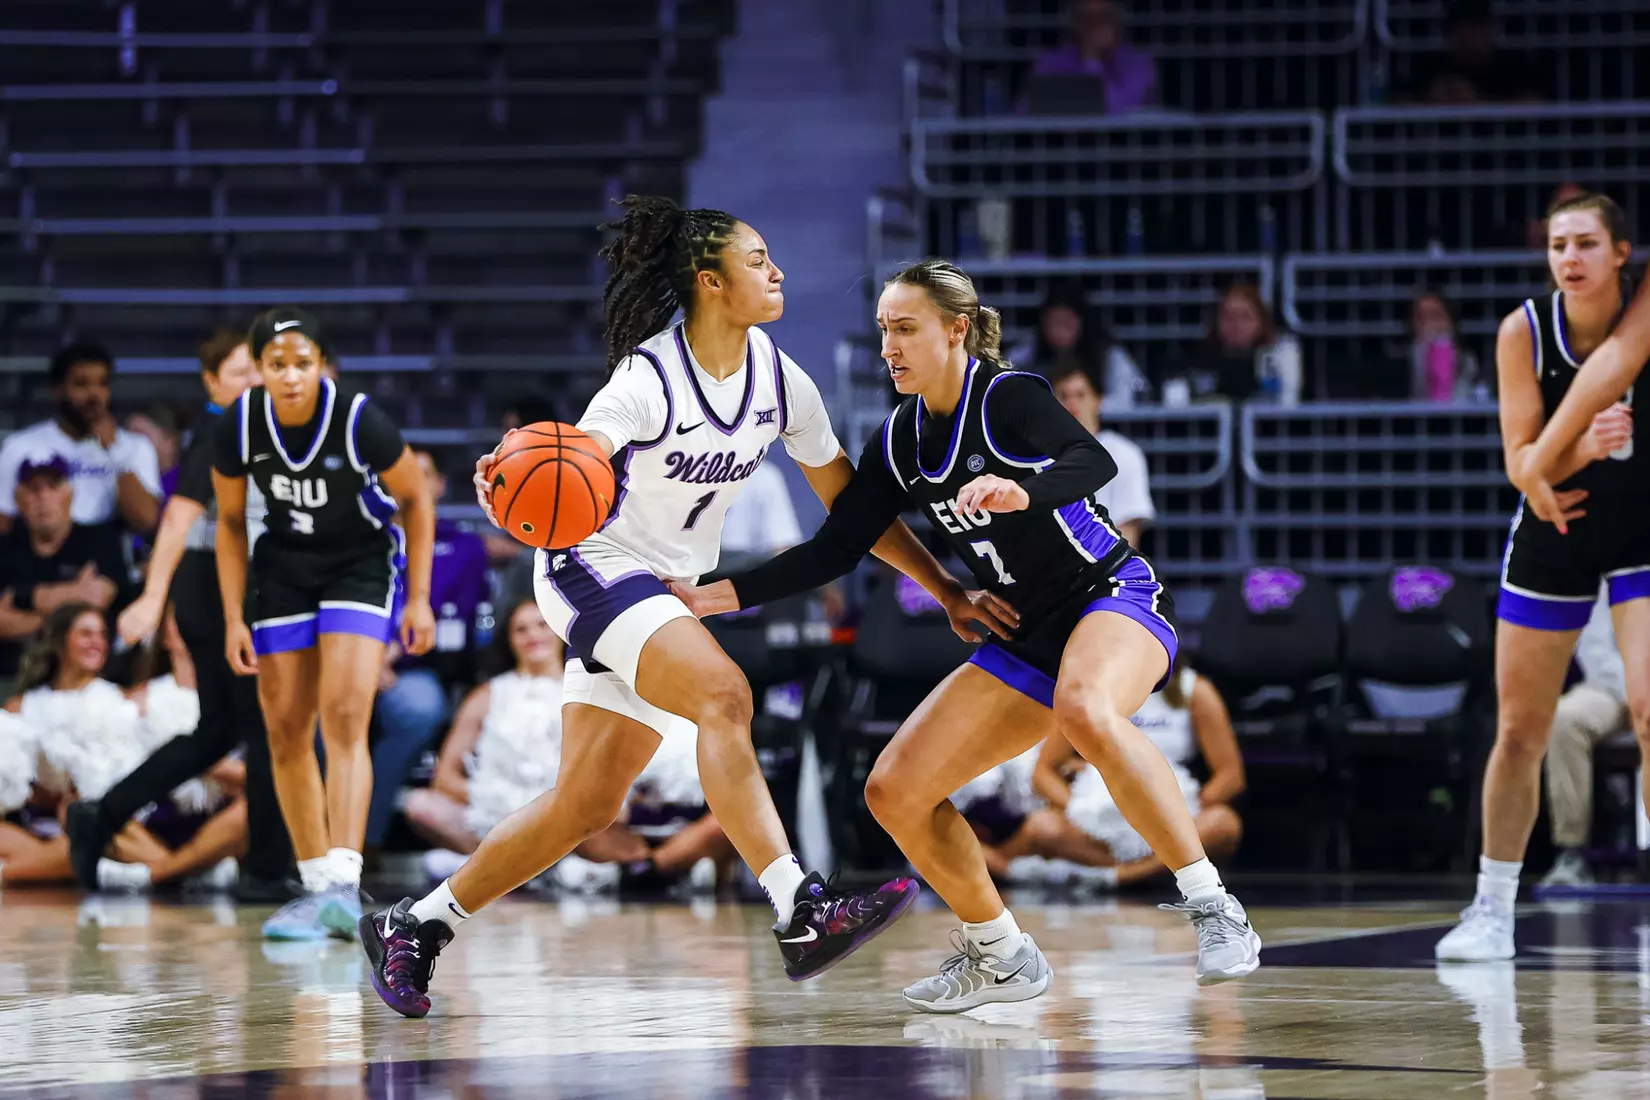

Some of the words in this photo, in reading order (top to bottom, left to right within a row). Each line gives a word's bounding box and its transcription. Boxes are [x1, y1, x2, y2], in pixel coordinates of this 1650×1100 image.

[270, 473, 329, 508] EIU
[680, 489, 720, 531] 1
[929, 498, 992, 534] EIU
[969, 539, 1017, 585] 7
